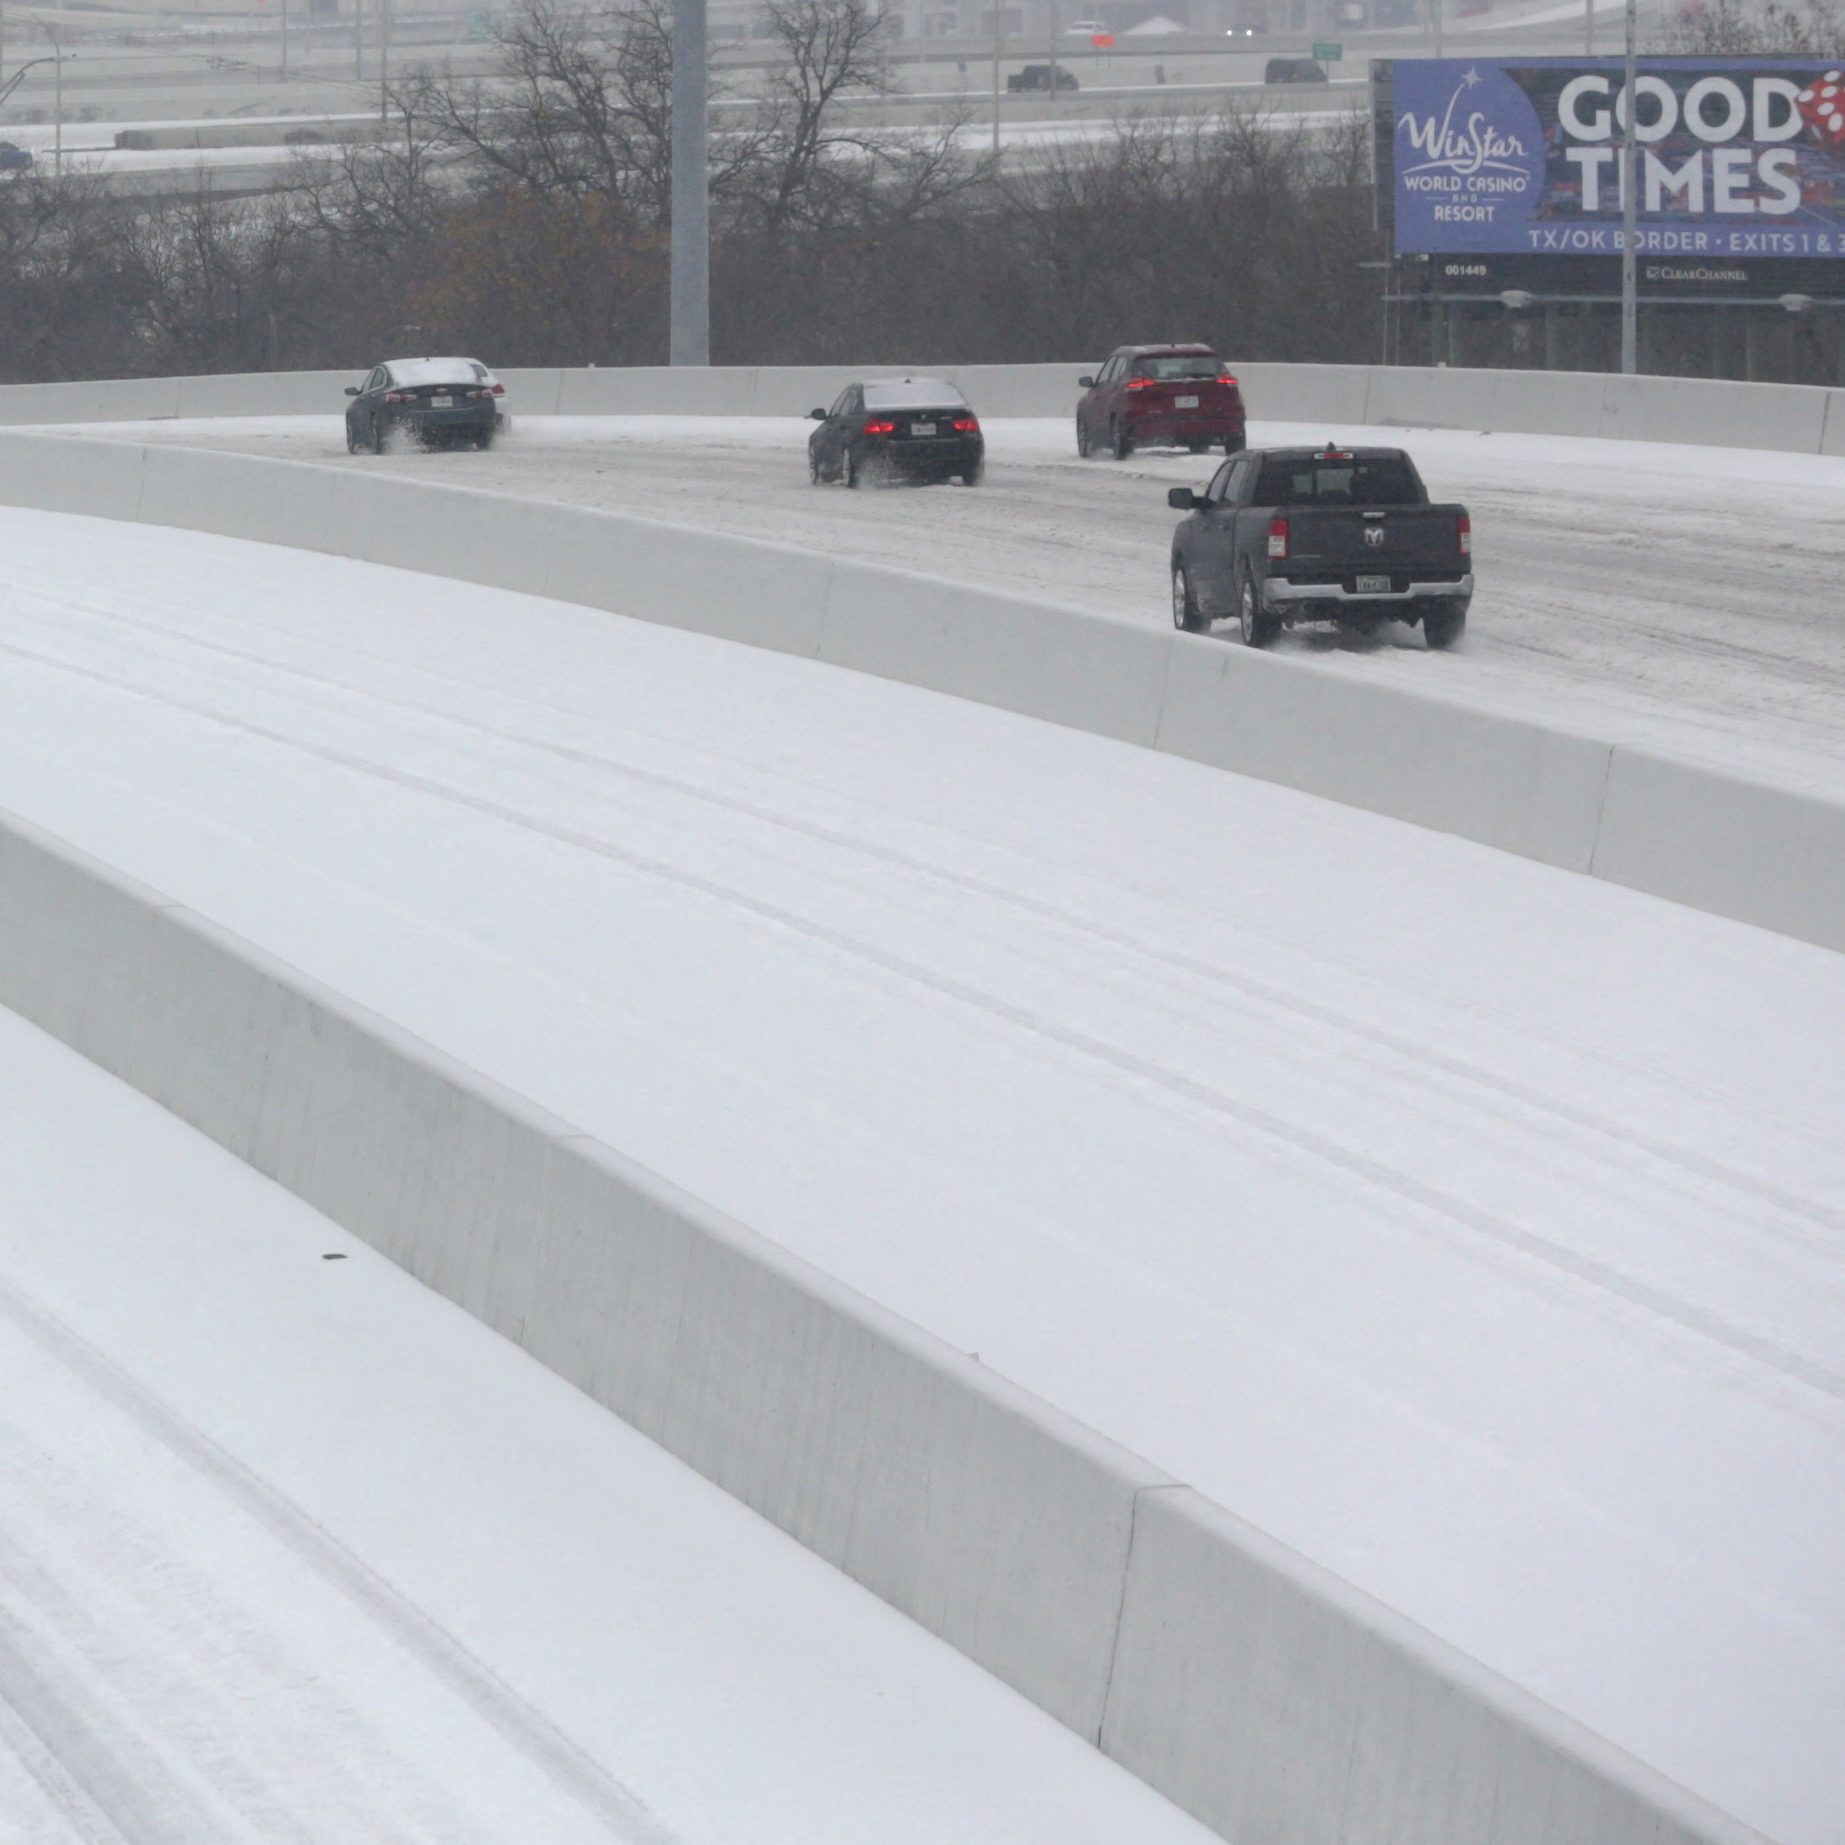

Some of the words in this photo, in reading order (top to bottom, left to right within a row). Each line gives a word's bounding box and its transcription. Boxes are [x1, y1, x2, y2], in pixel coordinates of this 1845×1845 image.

[1558, 74, 1803, 143] GOOD
[1397, 87, 1529, 175] WinStar
[1404, 176, 1461, 191] WORLD
[1467, 176, 1527, 192] CASINO
[1565, 147, 1802, 215] TIMES
[1452, 194, 1478, 203] AND
[1434, 205, 1496, 222] RESORT
[1528, 229, 1605, 250] TX/OK
[1614, 230, 1708, 250] BORDER
[1729, 233, 1795, 253] EXITS
[1801, 234, 1809, 253] 1
[1817, 234, 1831, 253] &
[1445, 265, 1487, 276] 001449
